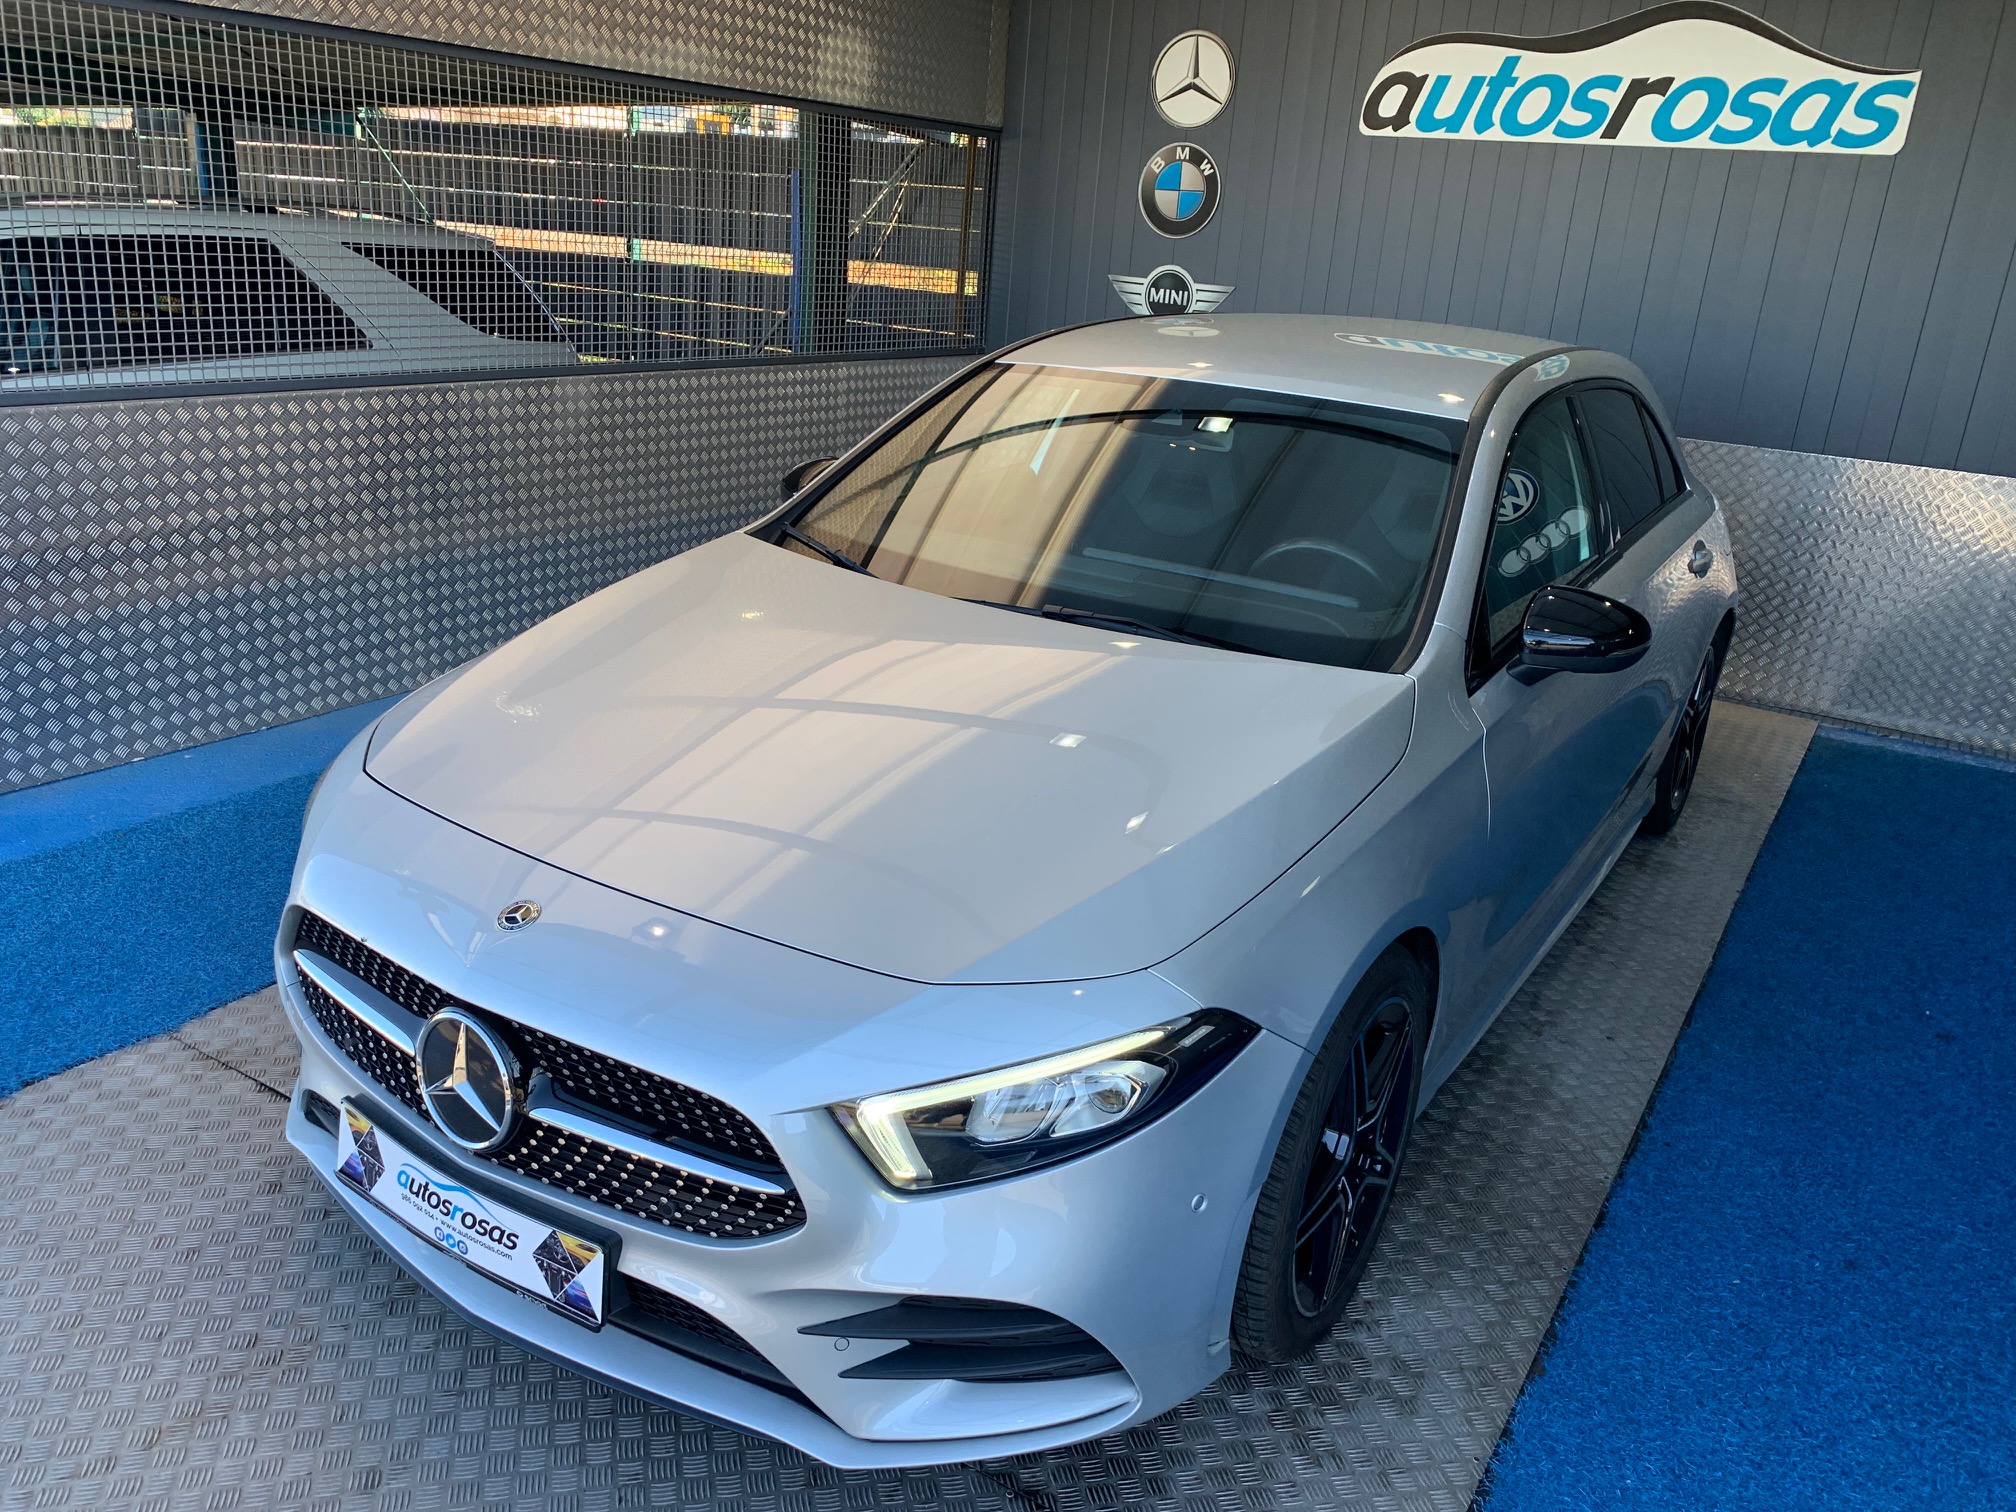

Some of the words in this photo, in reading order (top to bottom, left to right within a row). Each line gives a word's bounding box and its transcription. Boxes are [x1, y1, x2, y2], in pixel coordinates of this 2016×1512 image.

[1362, 55, 1917, 148] autosrosas
[1150, 146, 1214, 177] BMW
[1149, 287, 1189, 306] MINI
[397, 1169, 520, 1251] autosrosas
[440, 1218, 513, 1261] www.autosrosas.com
